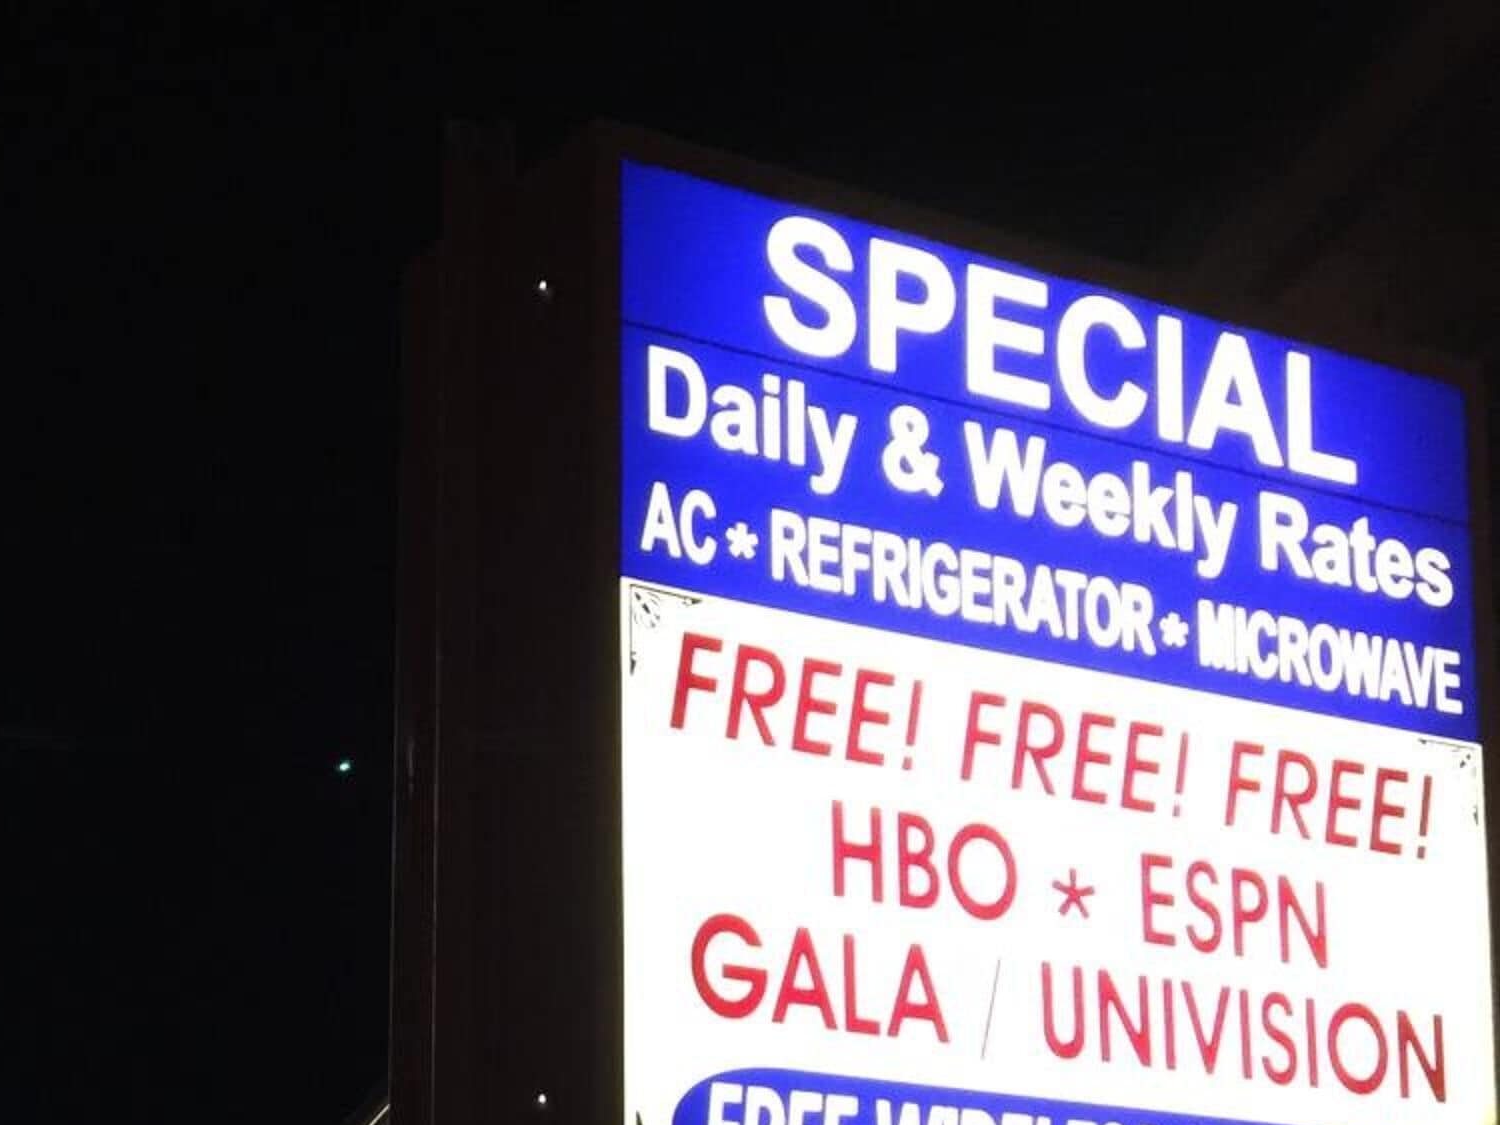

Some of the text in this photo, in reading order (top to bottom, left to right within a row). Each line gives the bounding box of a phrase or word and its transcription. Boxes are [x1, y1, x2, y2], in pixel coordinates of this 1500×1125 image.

[762, 214, 1358, 485] SPECIAL
[647, 345, 1455, 608] Daily & Weekly Rates
[640, 481, 1464, 715] AC REFRIGERATOR MICROWAVE
[670, 632, 1433, 859] FREE! FREE! FREE!
[831, 800, 1329, 969] HBO ESPN
[691, 912, 950, 1044] GALA
[1041, 961, 1448, 1104] UNIVISION
